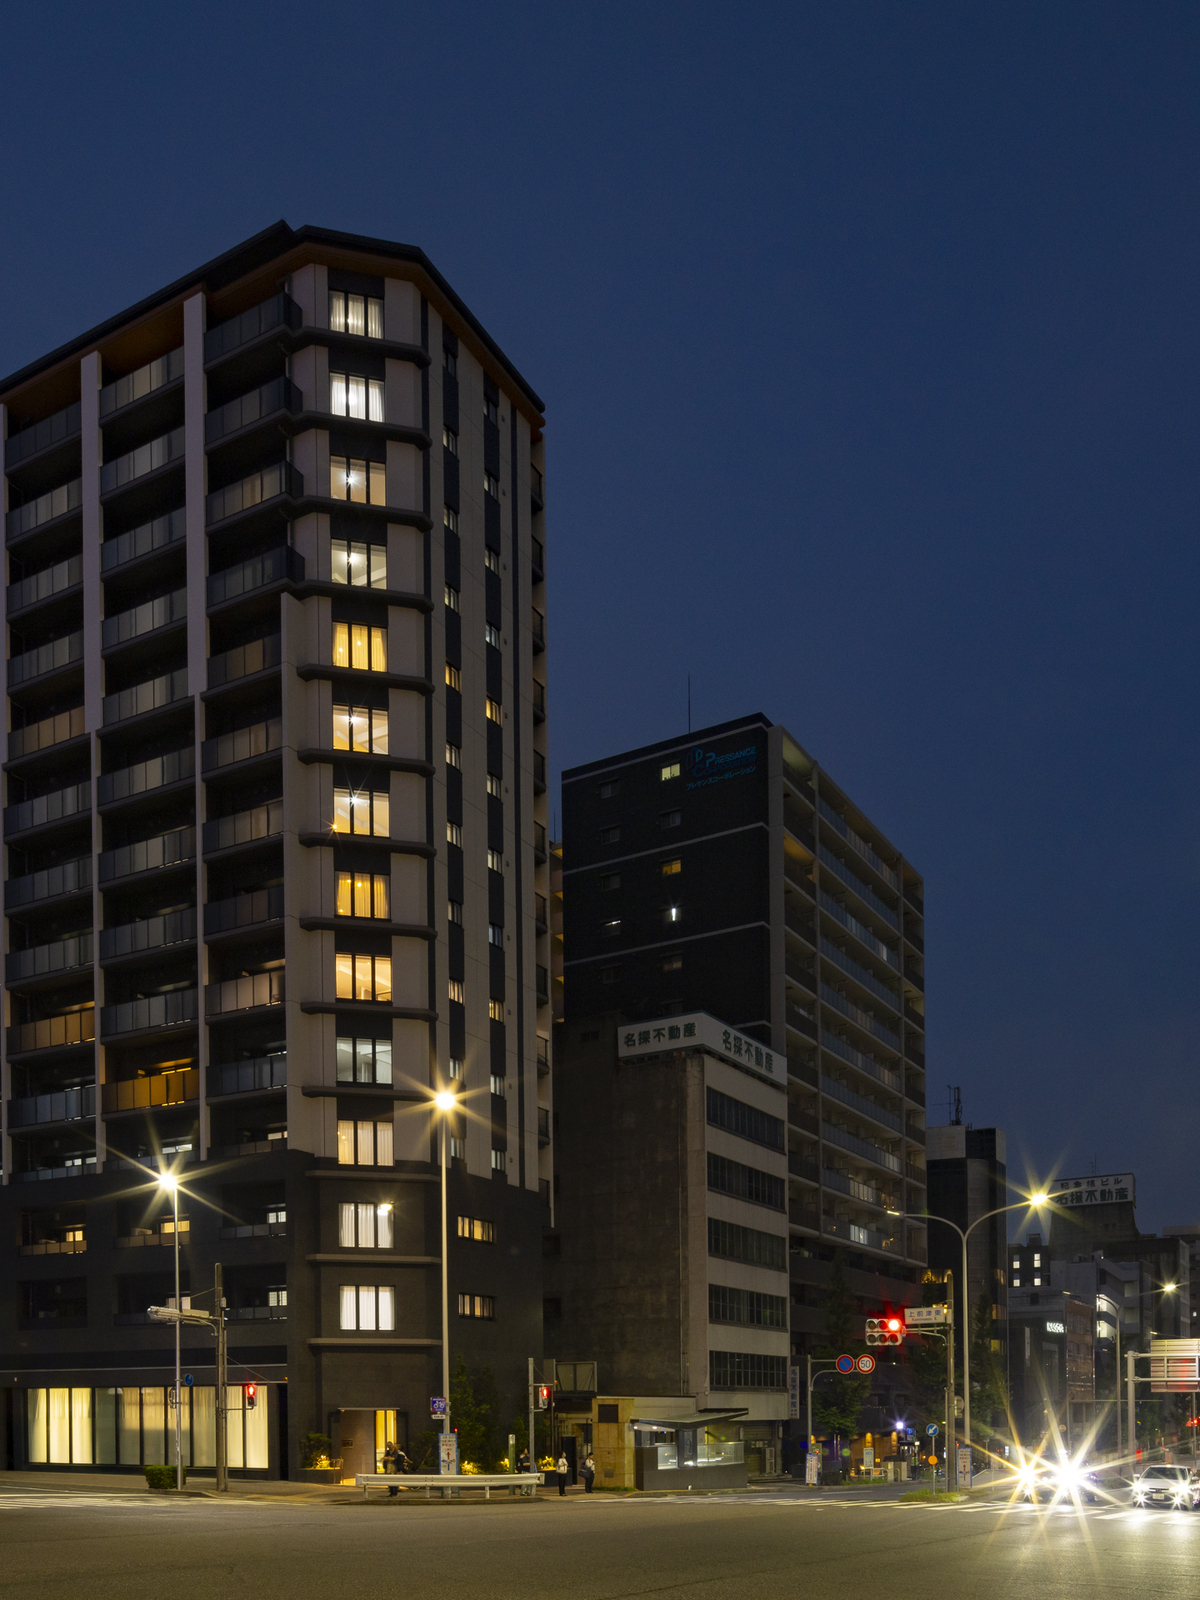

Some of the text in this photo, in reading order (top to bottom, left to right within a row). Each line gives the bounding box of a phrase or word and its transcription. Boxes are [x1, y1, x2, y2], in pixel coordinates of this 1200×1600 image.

[693, 755, 756, 778] CORPORATION
[706, 746, 756, 767] PRESSANCE
[687, 766, 756, 790] プレサンスコーポレーション
[624, 1023, 696, 1048] 名探不動産
[722, 1029, 774, 1074] 名探不動産
[1056, 1187, 1129, 1205] 名探不動産
[908, 1309, 941, 1318] 上前津東
[860, 1359, 871, 1369] 50
